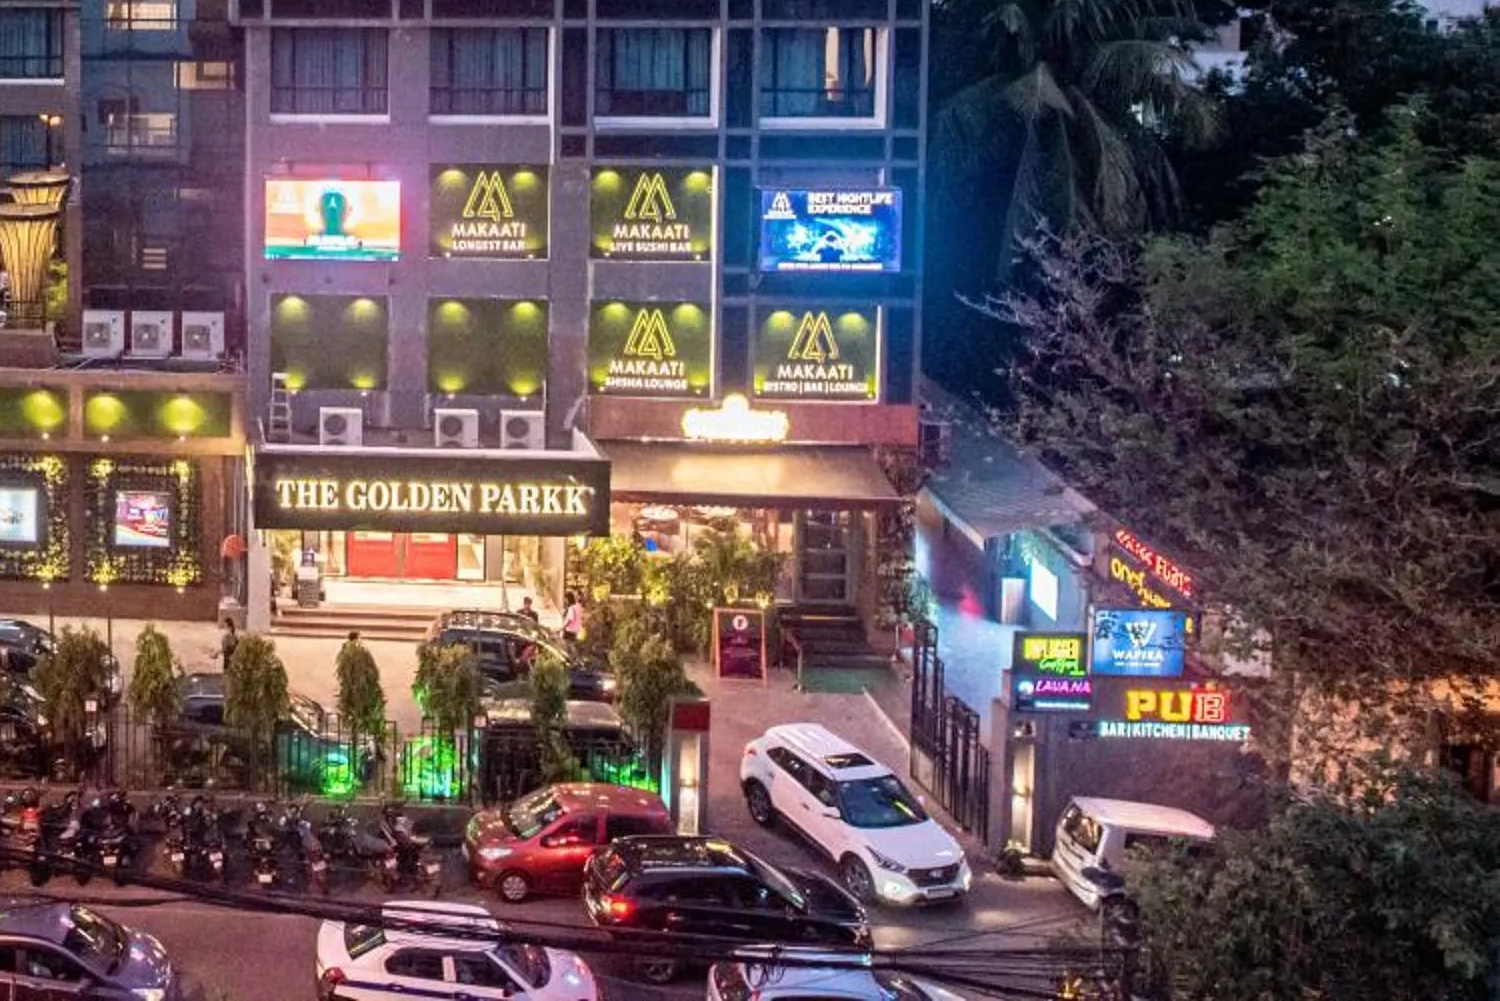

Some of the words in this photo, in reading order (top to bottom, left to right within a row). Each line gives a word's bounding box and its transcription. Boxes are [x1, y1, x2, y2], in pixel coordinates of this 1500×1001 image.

[452, 223, 526, 238] MAKAATI
[613, 224, 689, 239] MAKAATI
[609, 360, 685, 376] MAKAATI
[778, 364, 853, 380] MAKAATI
[276, 479, 339, 509] THE
[346, 481, 473, 512] GOLDEN
[1100, 722, 1128, 737] BAR
[1132, 723, 1186, 738] KITCHEN
